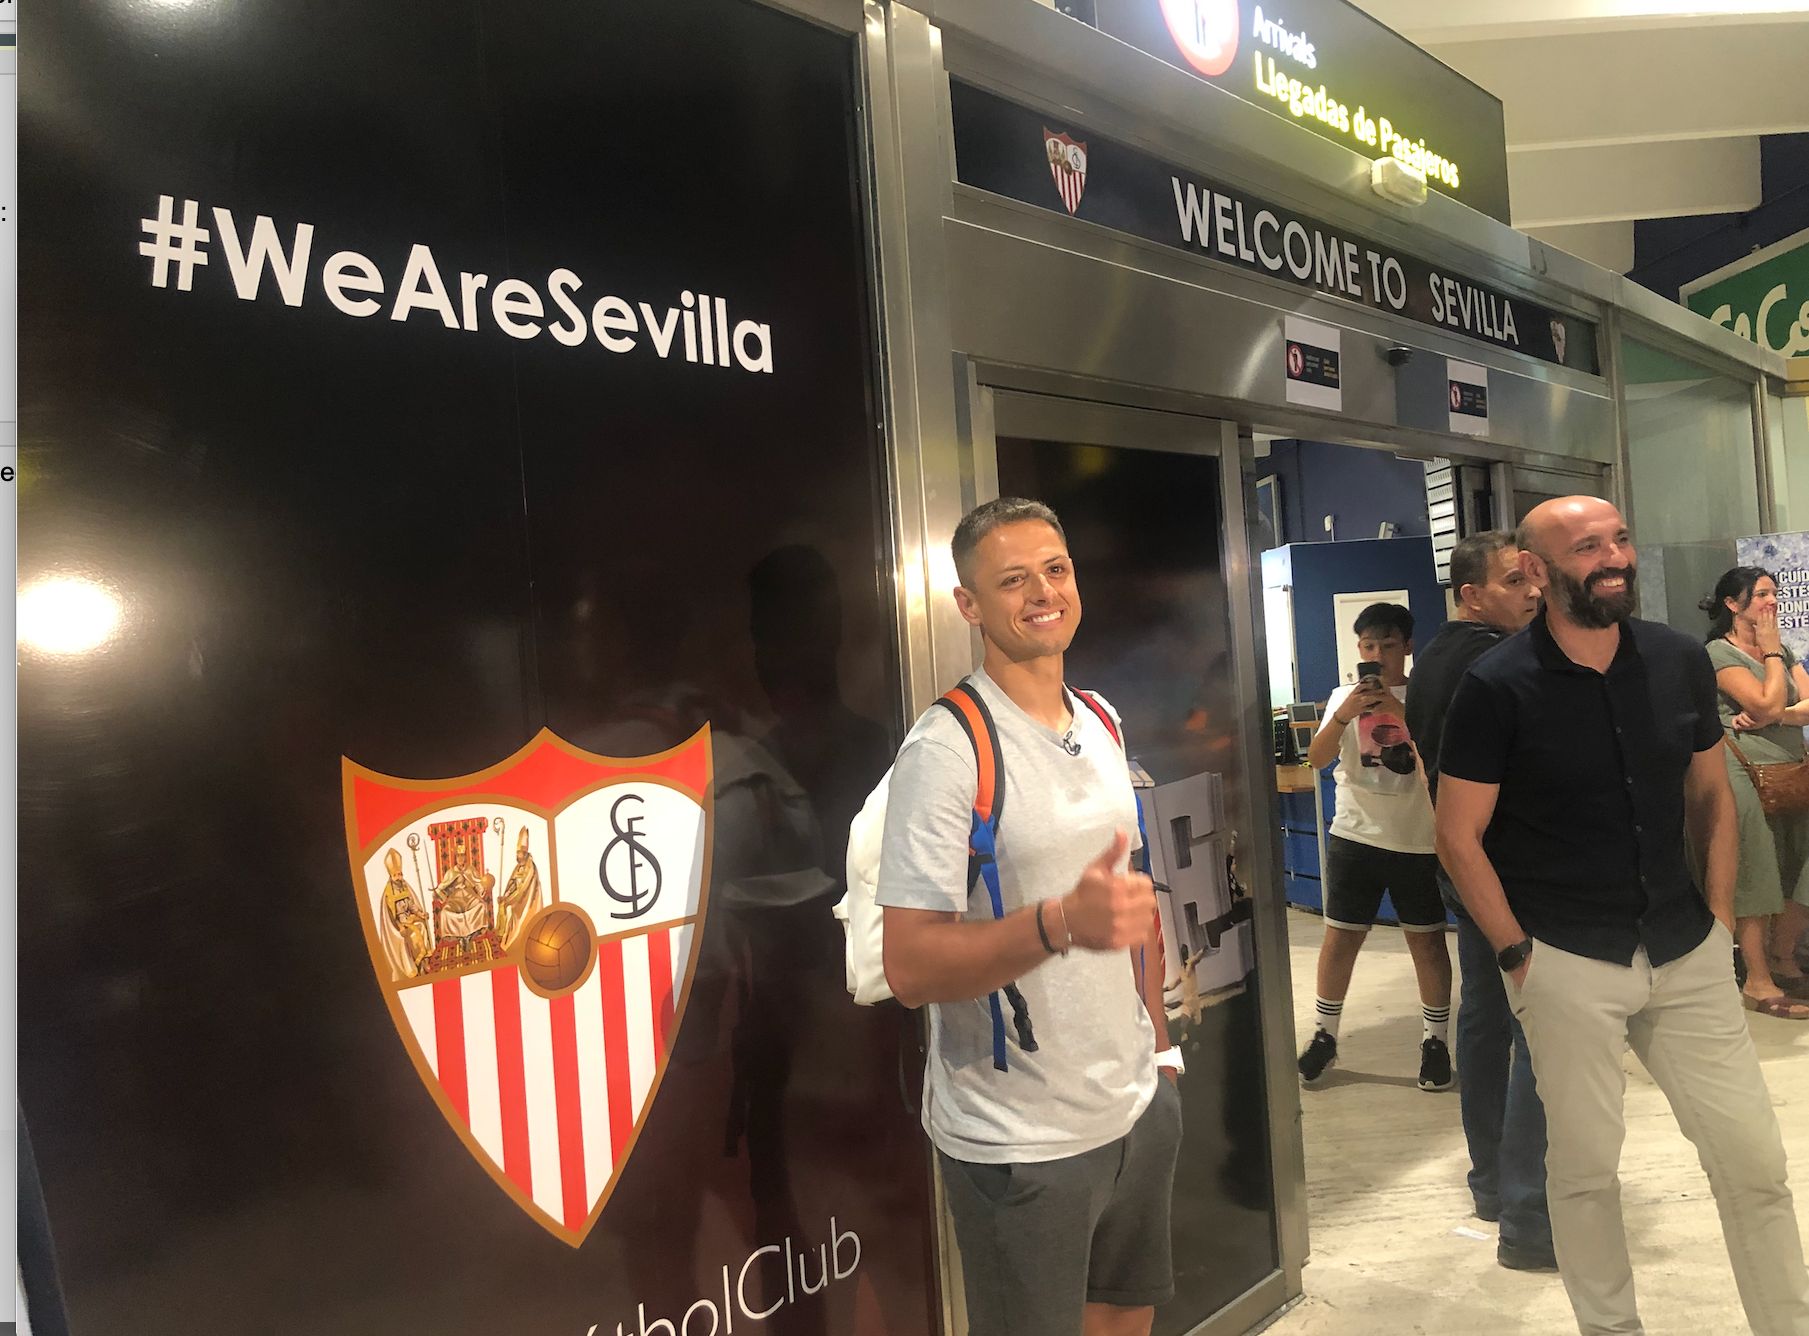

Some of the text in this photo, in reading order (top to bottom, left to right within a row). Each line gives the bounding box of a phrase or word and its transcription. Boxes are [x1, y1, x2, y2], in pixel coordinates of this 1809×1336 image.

[1253, 5, 1317, 69] Arrivals
[1254, 50, 1459, 188] Llegadas de Pasajeros
[139, 195, 773, 374] #WeAreSevilla
[1172, 176, 1520, 346] WELCOME TO SEVILLA
